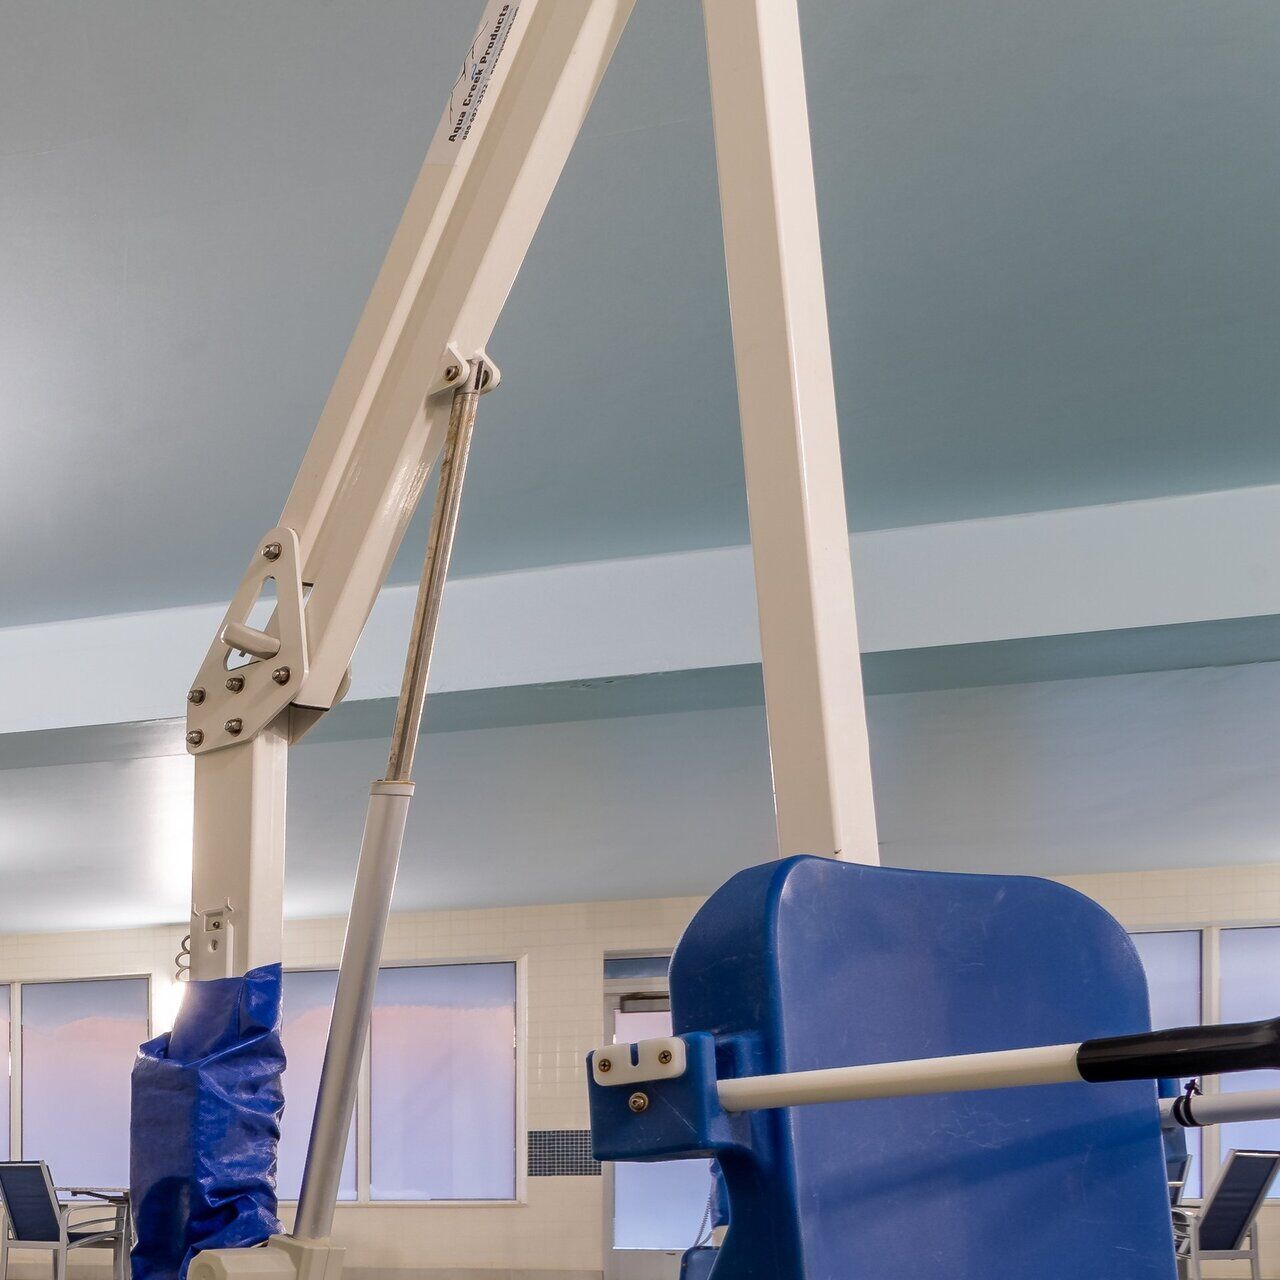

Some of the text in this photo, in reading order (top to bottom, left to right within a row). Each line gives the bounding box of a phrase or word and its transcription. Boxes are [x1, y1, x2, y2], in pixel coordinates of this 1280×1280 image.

[448, 4, 510, 142] Aqua Creek Products
